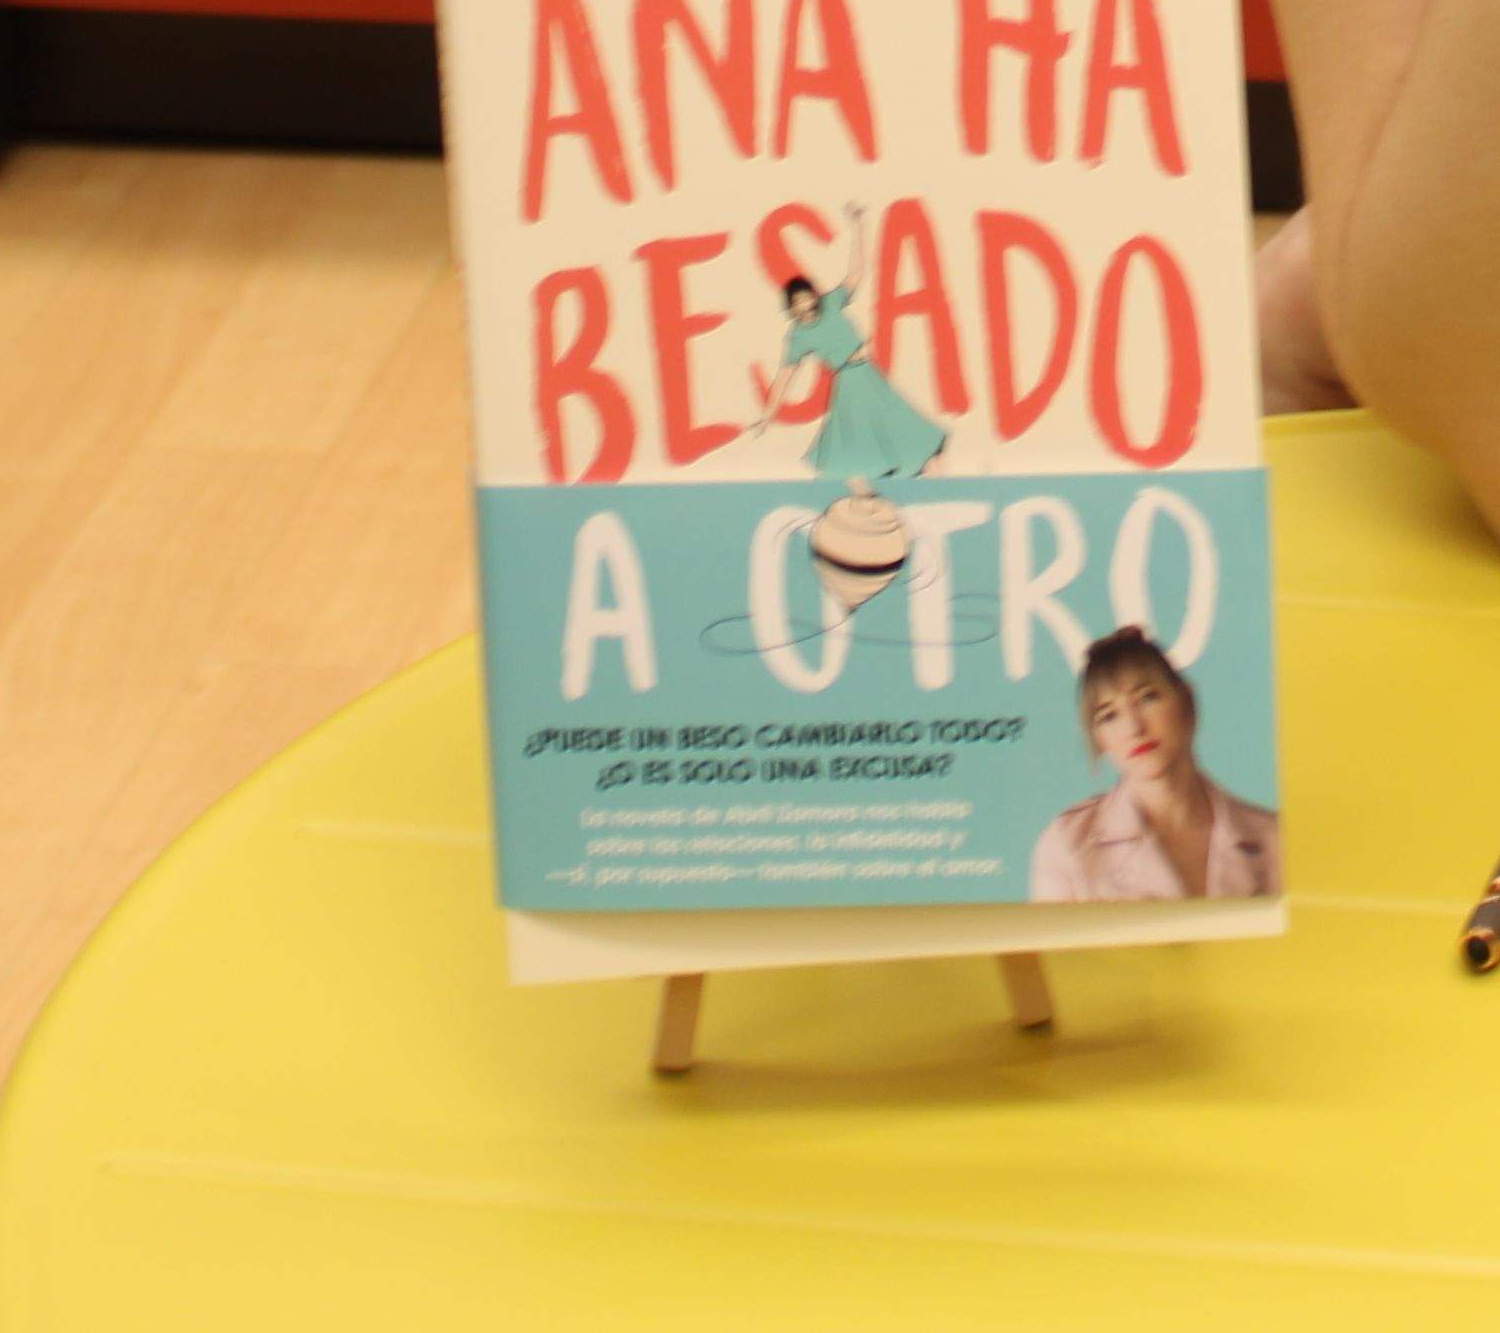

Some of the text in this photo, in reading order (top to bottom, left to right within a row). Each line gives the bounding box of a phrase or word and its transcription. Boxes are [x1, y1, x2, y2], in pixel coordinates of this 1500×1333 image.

[532, 197, 1206, 487] BESADO
[560, 486, 1219, 701] A OTRO
